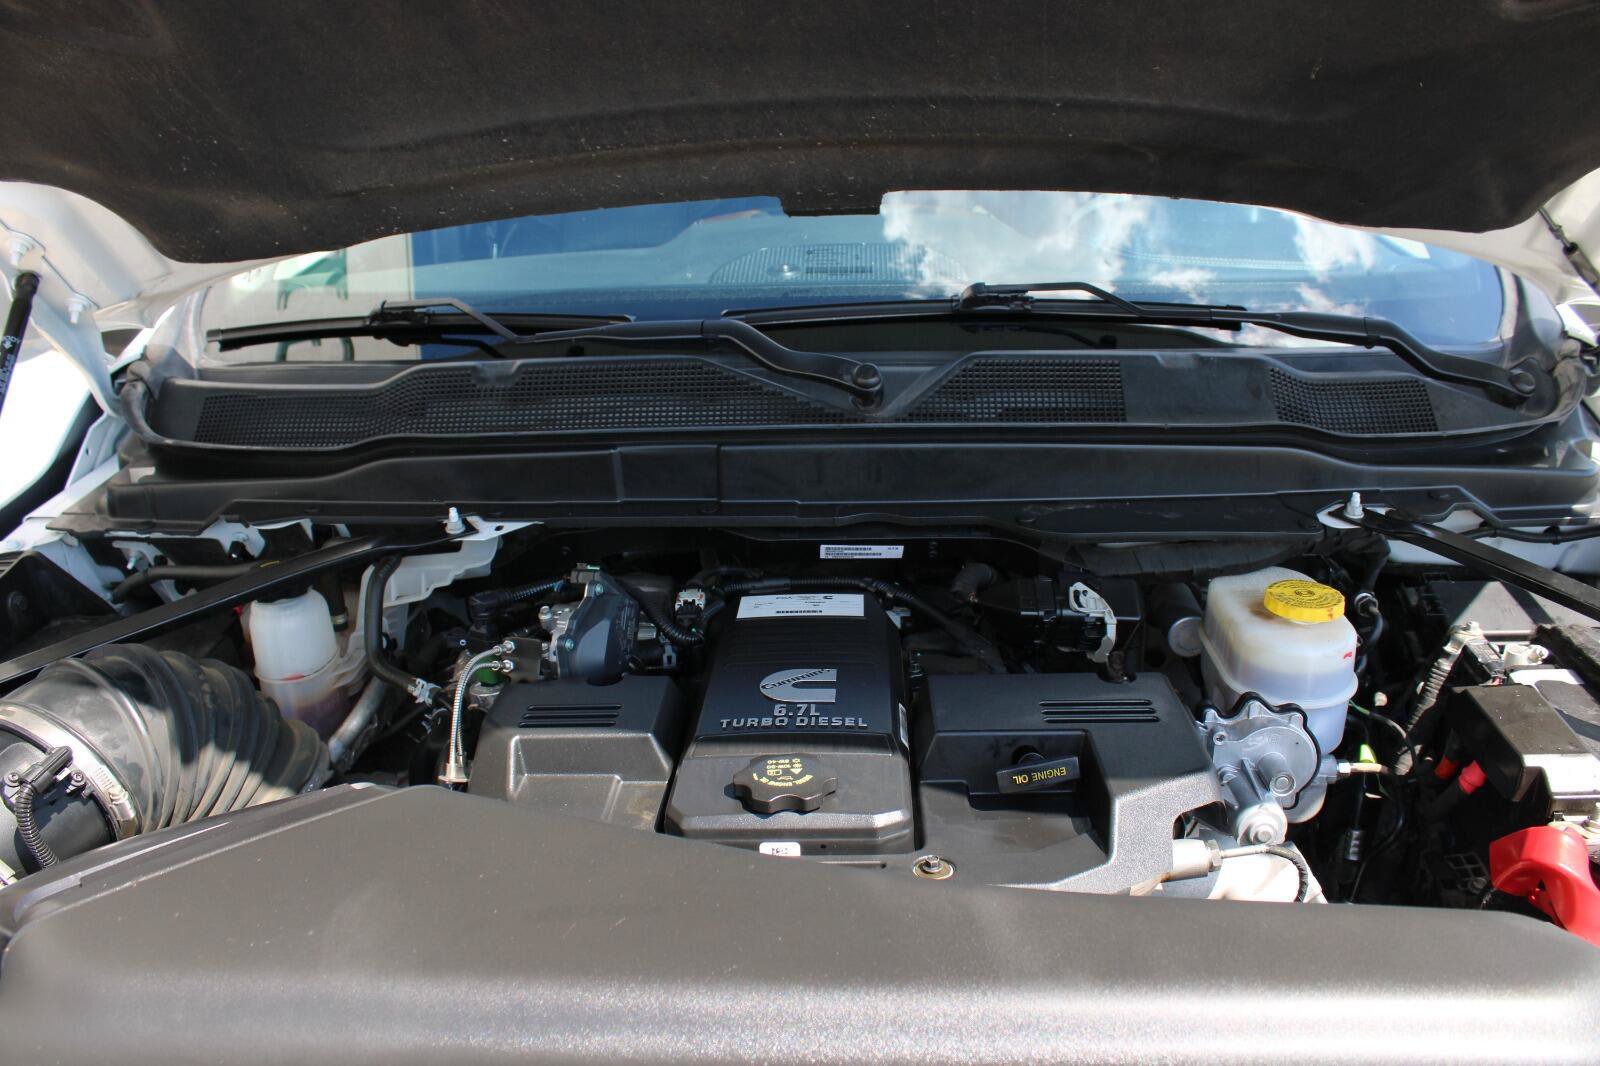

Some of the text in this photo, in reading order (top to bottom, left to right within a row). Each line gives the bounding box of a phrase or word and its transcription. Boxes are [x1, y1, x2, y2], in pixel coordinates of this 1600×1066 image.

[760, 668, 832, 690] Cummins
[774, 703, 821, 717] 6.7L
[720, 716, 868, 729] TURBO DIESEL
[1012, 766, 1067, 785] ENGINE OIL
